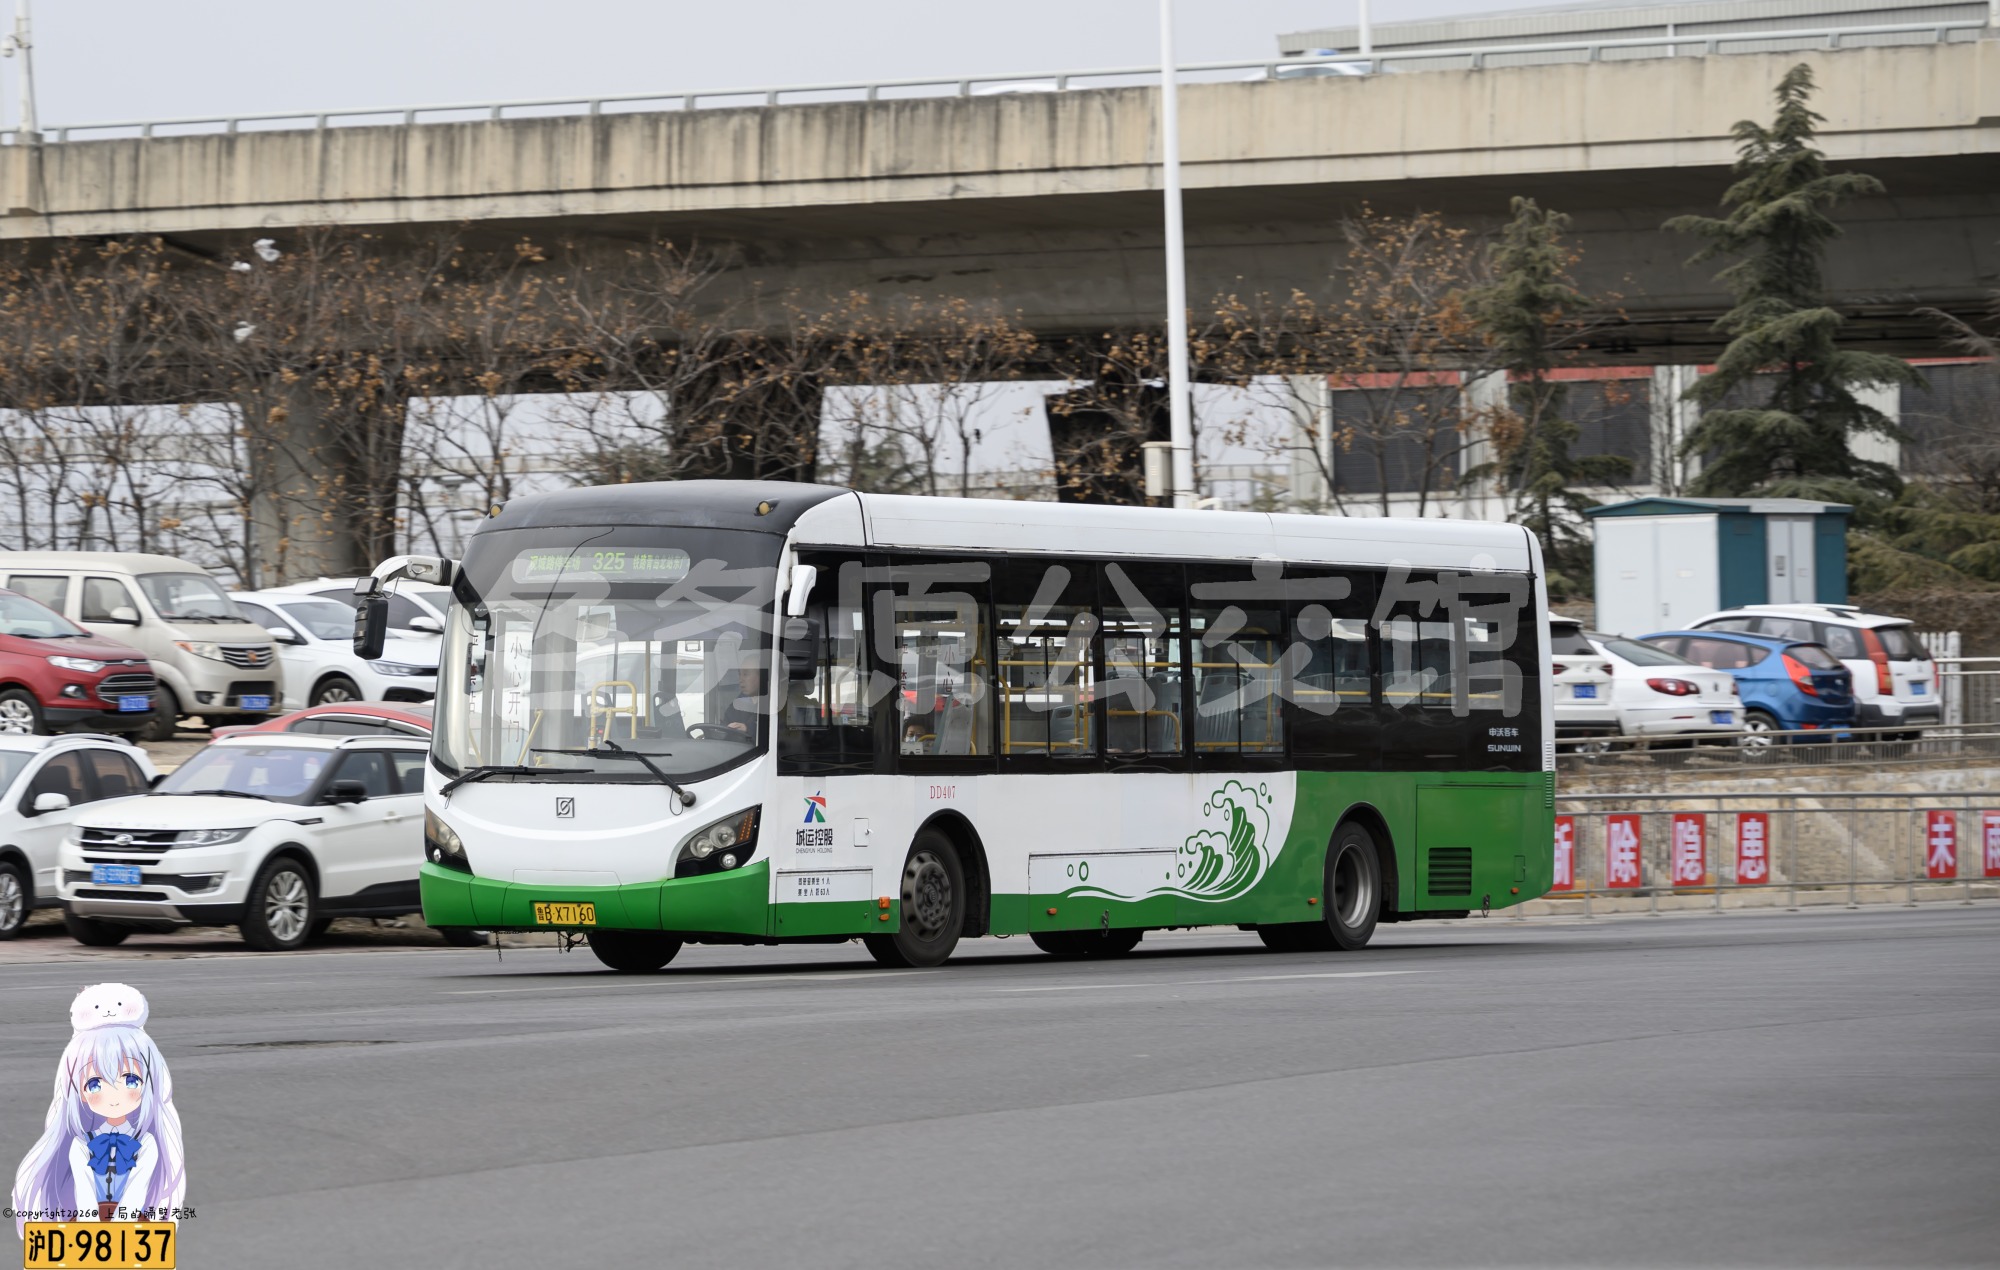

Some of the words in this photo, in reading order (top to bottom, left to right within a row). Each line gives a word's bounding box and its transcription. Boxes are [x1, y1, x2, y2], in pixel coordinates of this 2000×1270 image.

[592, 552, 626, 571] 325
[1489, 727, 1519, 737] 申沃客车
[1488, 744, 1521, 752] SUNWIN
[930, 786, 956, 799] DD407
[796, 828, 833, 846] 城运控股
